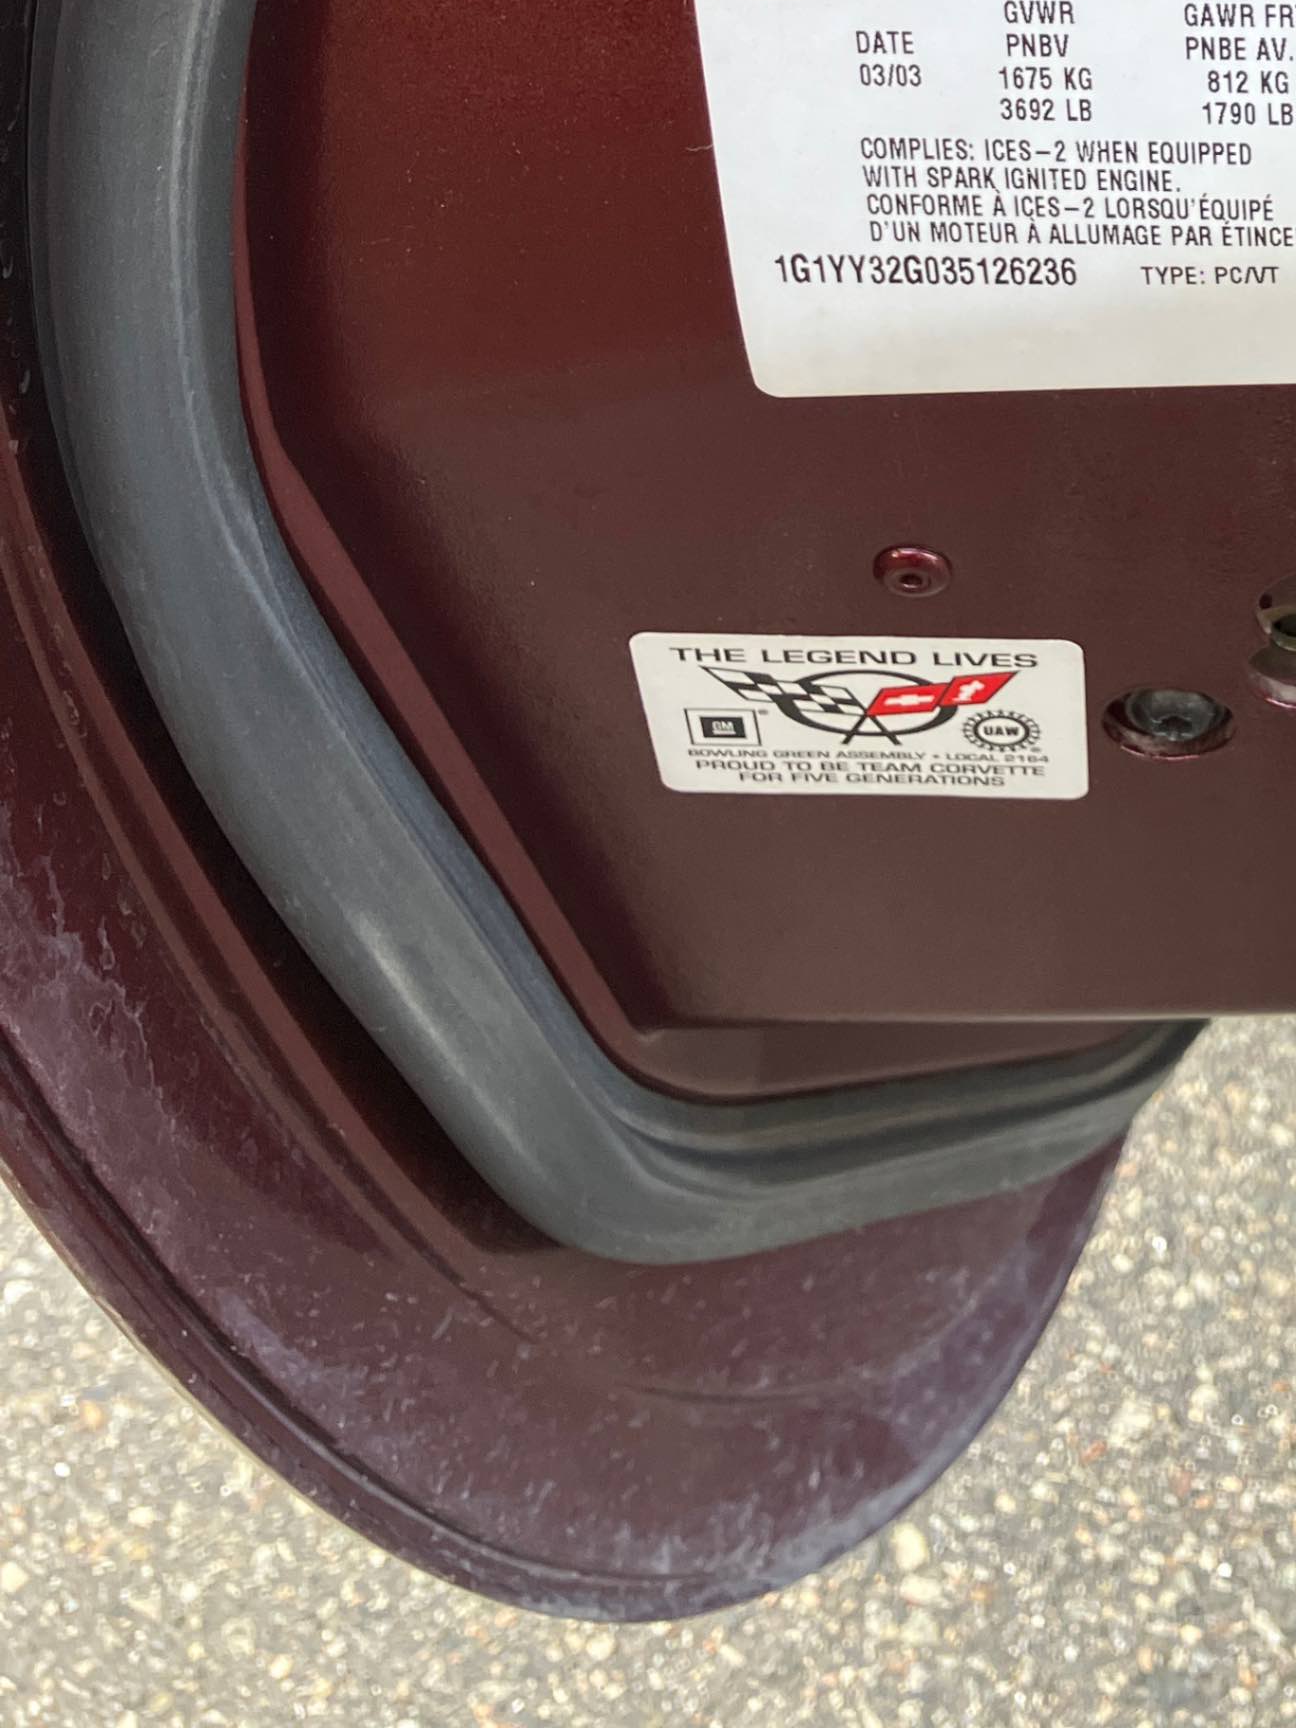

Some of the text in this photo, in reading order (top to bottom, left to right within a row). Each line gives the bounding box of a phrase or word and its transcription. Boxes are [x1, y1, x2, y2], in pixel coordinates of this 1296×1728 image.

[1004, 1, 1076, 25] GVWR
[1184, 4, 1255, 27] GAWR
[856, 31, 915, 56] DATE
[1006, 34, 1070, 57] PNBV
[1185, 37, 1295, 62] PNBE AV.
[859, 64, 922, 87] 03/03
[999, 67, 1093, 91] 1675 KG
[1207, 71, 1290, 94] 812 KG
[1000, 99, 1093, 123] 3692 LB
[1201, 102, 1294, 126] 1790 LB
[860, 137, 975, 161] COMPLIES:
[1076, 141, 1138, 164] WHEN
[1148, 141, 1252, 166] EQUIPPED
[863, 166, 1181, 193] WITH SPARK IGNITED ENGINE.
[866, 193, 984, 217] CONFORME
[992, 189, 1006, 217] À
[1105, 193, 1274, 221] LORSQU'ÉQUIPÉ
[870, 221, 920, 243] D'UN
[930, 221, 1017, 244] MOTEUR
[1028, 217, 1040, 244] À
[1049, 221, 1162, 246] ALLUMAGE
[1171, 225, 1213, 247] PAR
[775, 254, 1077, 285] 1G1YY32G035126236
[1141, 265, 1206, 286] TYPE:
[669, 646, 1039, 667] THE LEGEND LIVES
[983, 724, 1021, 737] UAW
[688, 749, 768, 757] BOWLING
[773, 750, 833, 758] GREEN
[836, 749, 926, 760] ASSEMBLY
[947, 752, 999, 761] LOCAL
[696, 760, 1045, 776] PROUD TO BE TEAM CORVETTE
[739, 773, 1005, 786] FOR FIVE GENERATIONS
